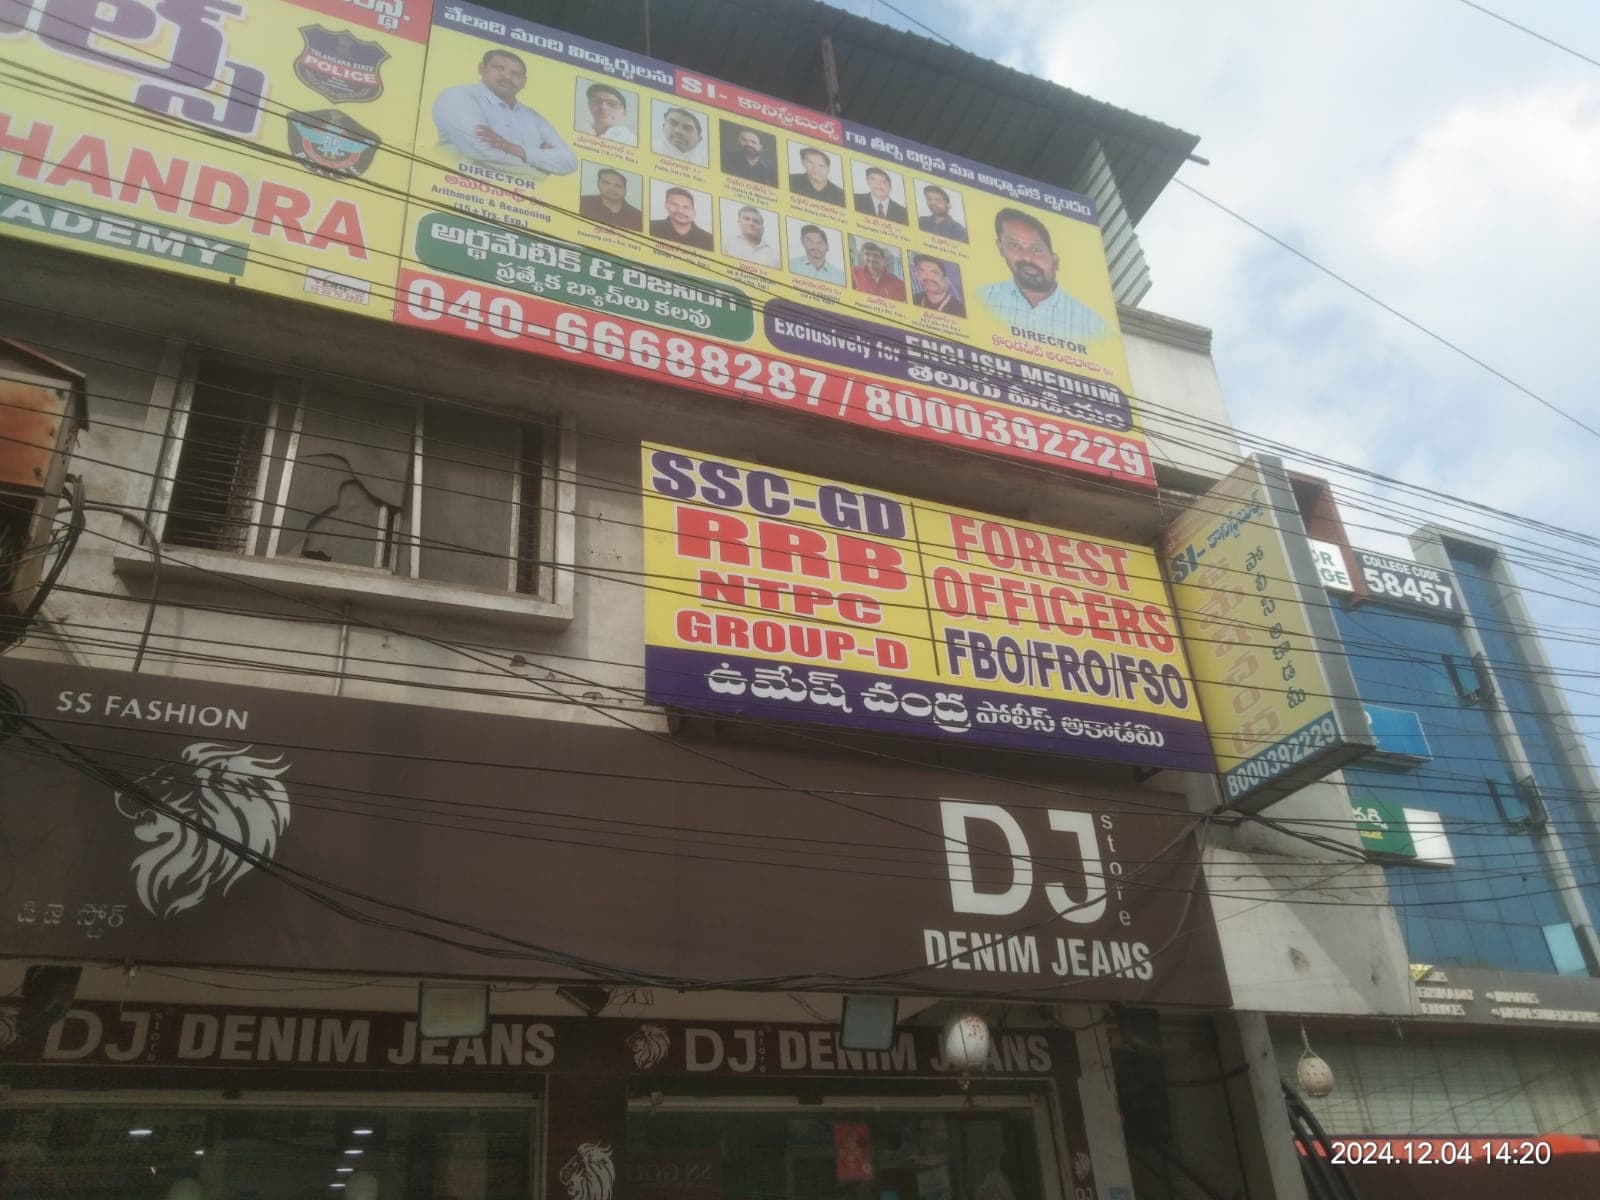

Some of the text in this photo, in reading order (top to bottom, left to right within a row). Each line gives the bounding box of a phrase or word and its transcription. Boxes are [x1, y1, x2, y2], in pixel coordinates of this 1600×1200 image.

[304, 55, 377, 84] POLICE
[510, 25, 564, 53] మంది
[949, 162, 975, 180] మా
[458, 163, 536, 190] DIRECTOR
[431, 185, 485, 205] Arithmetic
[488, 199, 496, 208] &
[499, 201, 551, 223] Reasoning
[1, 199, 232, 265] ADEMY
[589, 257, 616, 283] &
[654, 300, 712, 329] కలవు
[1010, 325, 1088, 355] DIRECTOR
[407, 278, 828, 407] 040-66688287
[864, 383, 1147, 478] 8000392229
[875, 341, 900, 362] for
[905, 335, 1013, 378] ENGLISH
[1020, 364, 1121, 408] MEDIUM
[650, 450, 907, 539] SSC-GD
[676, 506, 908, 592] RRB
[949, 514, 1128, 592] FOREST
[1362, 554, 1440, 582] COLLEGE CODE
[700, 570, 883, 625] NTPC
[933, 566, 1177, 655] OFFICERS
[1363, 568, 1453, 609] 58457
[677, 610, 909, 672] GROUP-D
[945, 627, 1189, 711] FBO/FRO/FSO
[56, 691, 249, 731] SS FASHION
[704, 662, 853, 713] ఉమేష్
[860, 681, 972, 733] చంద్ర
[1226, 717, 1337, 798] 8000392229
[939, 797, 1107, 924] DJ
[923, 929, 1154, 980] DENIM JEANS
[43, 1008, 150, 1062] DJ
[177, 1013, 556, 1067] DENIM JEANS
[685, 1028, 757, 1073] DJ
[931, 1033, 1052, 1074] JANS
